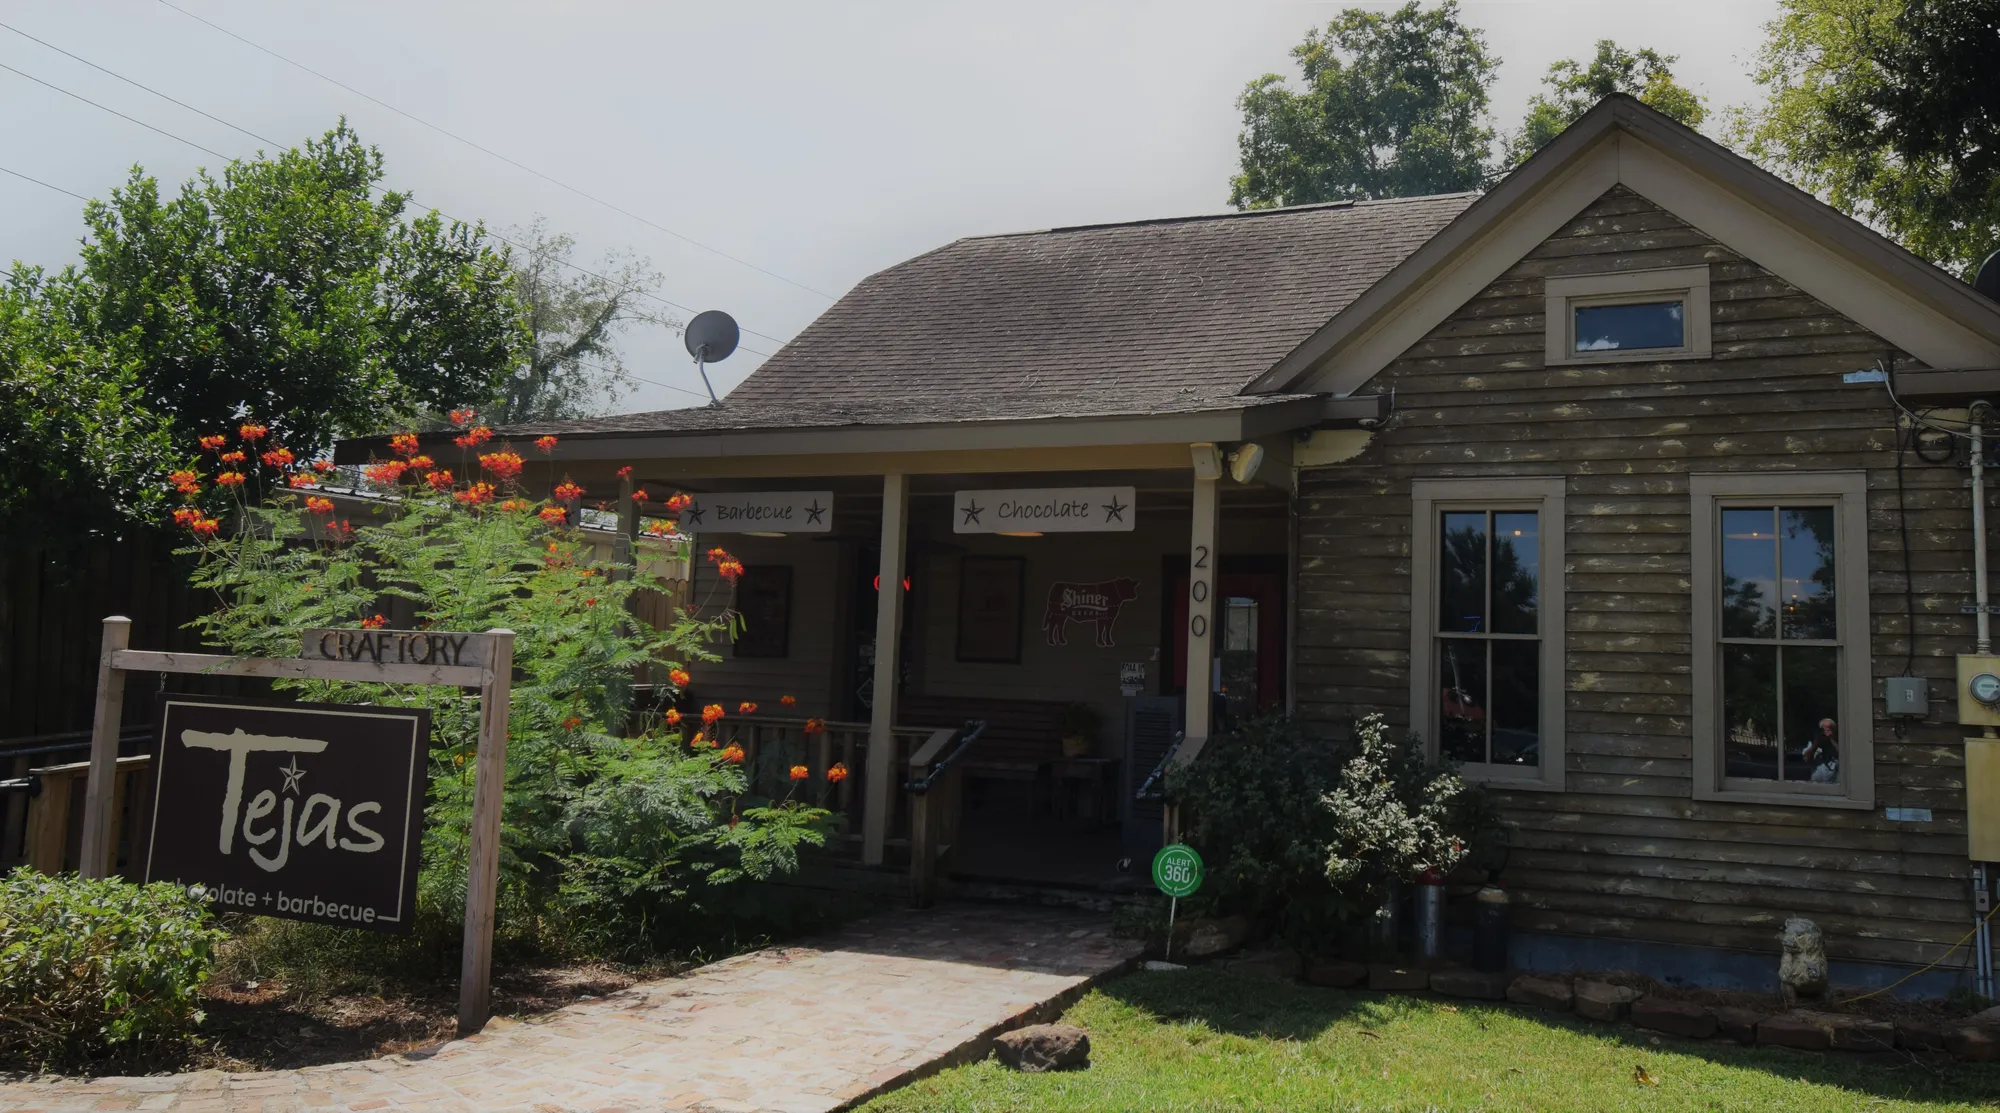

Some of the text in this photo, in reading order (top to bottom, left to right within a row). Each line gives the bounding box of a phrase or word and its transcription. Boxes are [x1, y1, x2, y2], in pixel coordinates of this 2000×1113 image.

[716, 501, 793, 520] Barbecue
[998, 499, 1089, 519] Chocolate
[1060, 587, 1109, 611] Shiner
[319, 631, 469, 665] CRAFTORY
[181, 728, 385, 872] Tejas
[1166, 857, 1191, 867] ALERT
[1164, 864, 1191, 884] 360
[262, 892, 273, 906] +
[277, 890, 376, 923] barbecue
